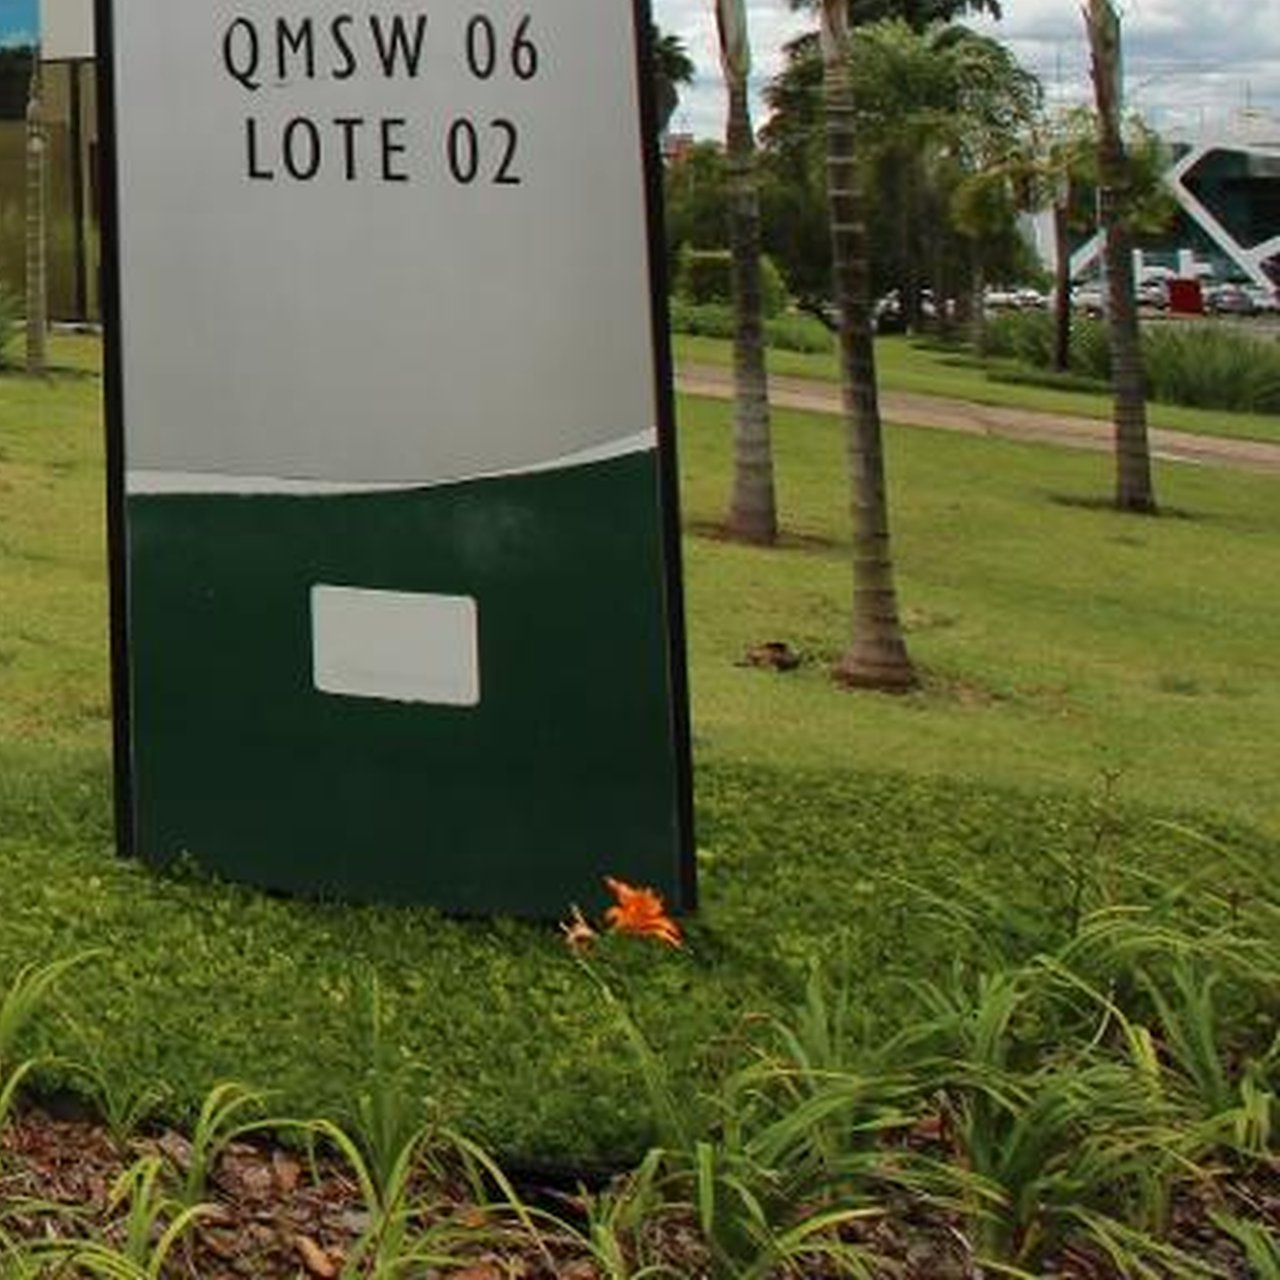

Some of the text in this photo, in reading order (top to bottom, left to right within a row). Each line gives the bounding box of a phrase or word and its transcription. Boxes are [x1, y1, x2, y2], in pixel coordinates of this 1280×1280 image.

[222, 14, 540, 91] QMSW 06
[245, 117, 522, 185] LOTE 02
